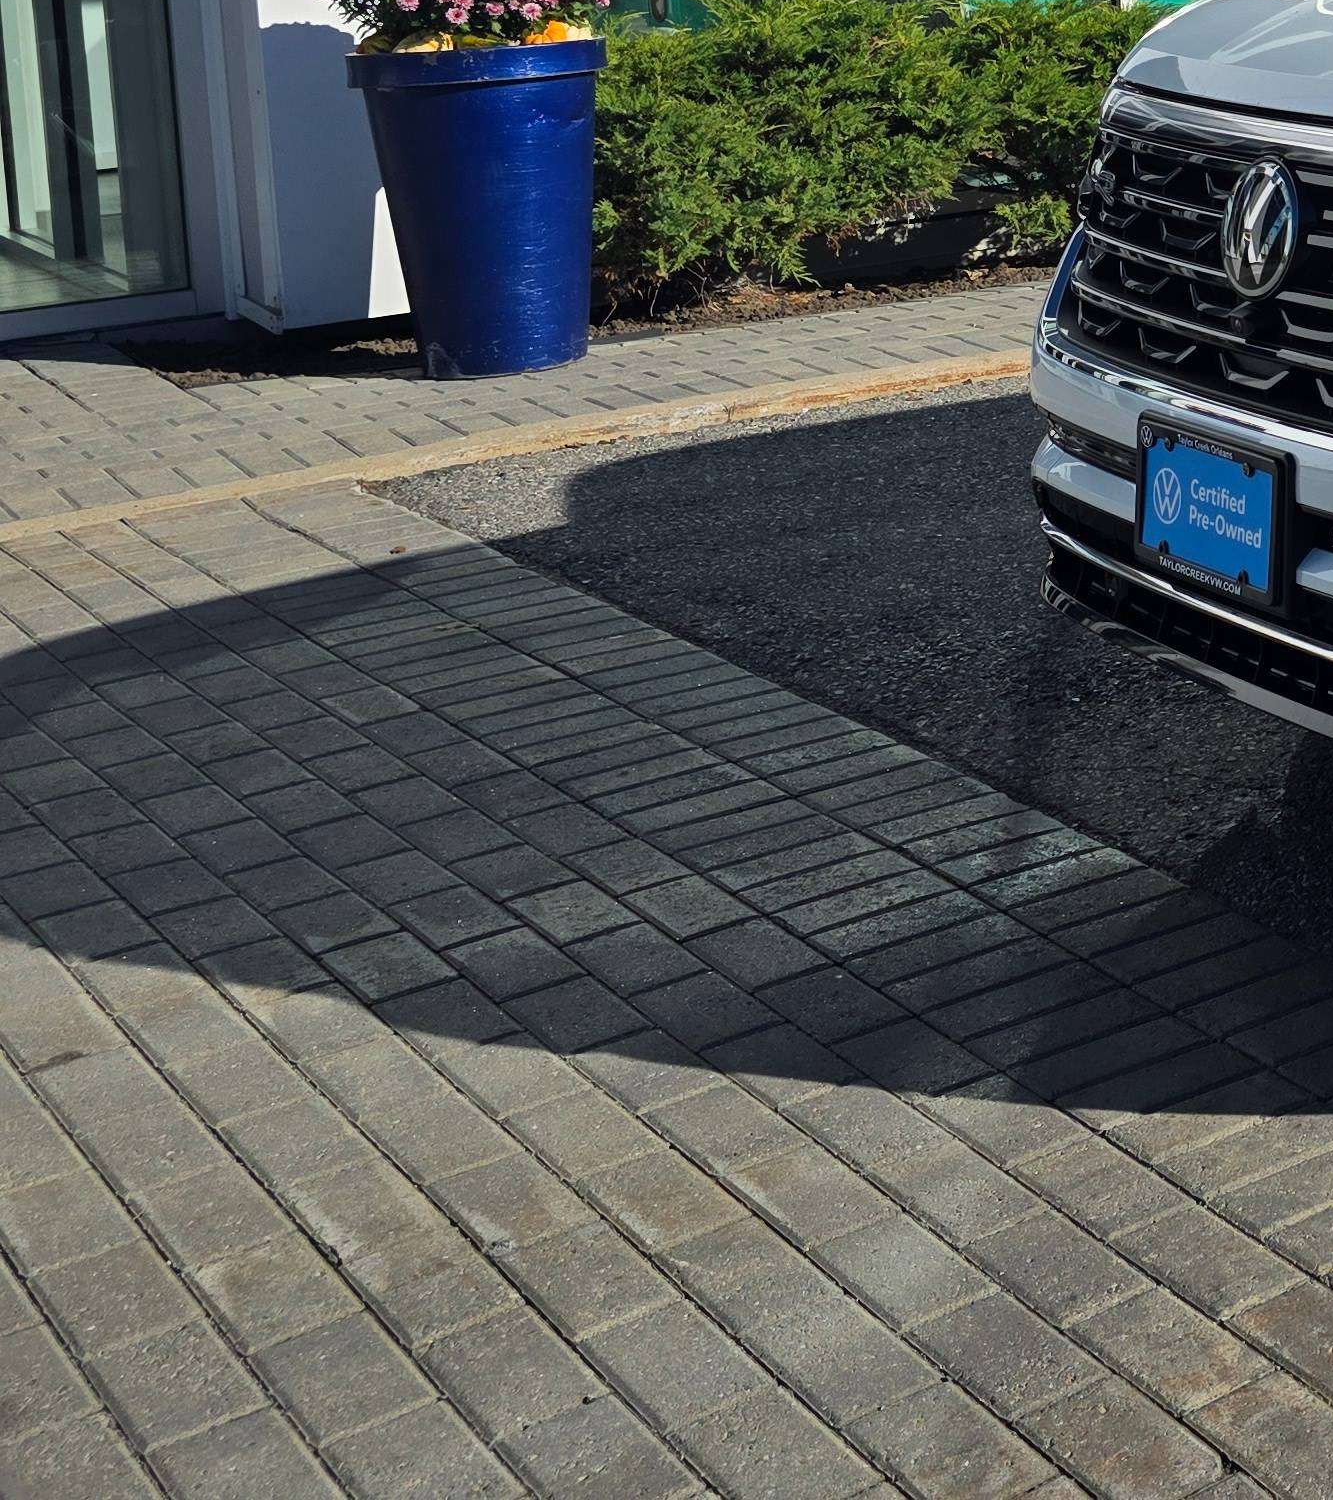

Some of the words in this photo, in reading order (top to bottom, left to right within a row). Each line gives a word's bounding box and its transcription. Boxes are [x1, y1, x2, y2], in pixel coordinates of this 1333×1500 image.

[1177, 434, 1194, 448] Taylor
[1194, 440, 1210, 452] Creek
[1190, 479, 1247, 515] Certified
[1189, 505, 1262, 549] Pre-Owned
[1158, 555, 1242, 596] TAYLORCREEKVW.COM
